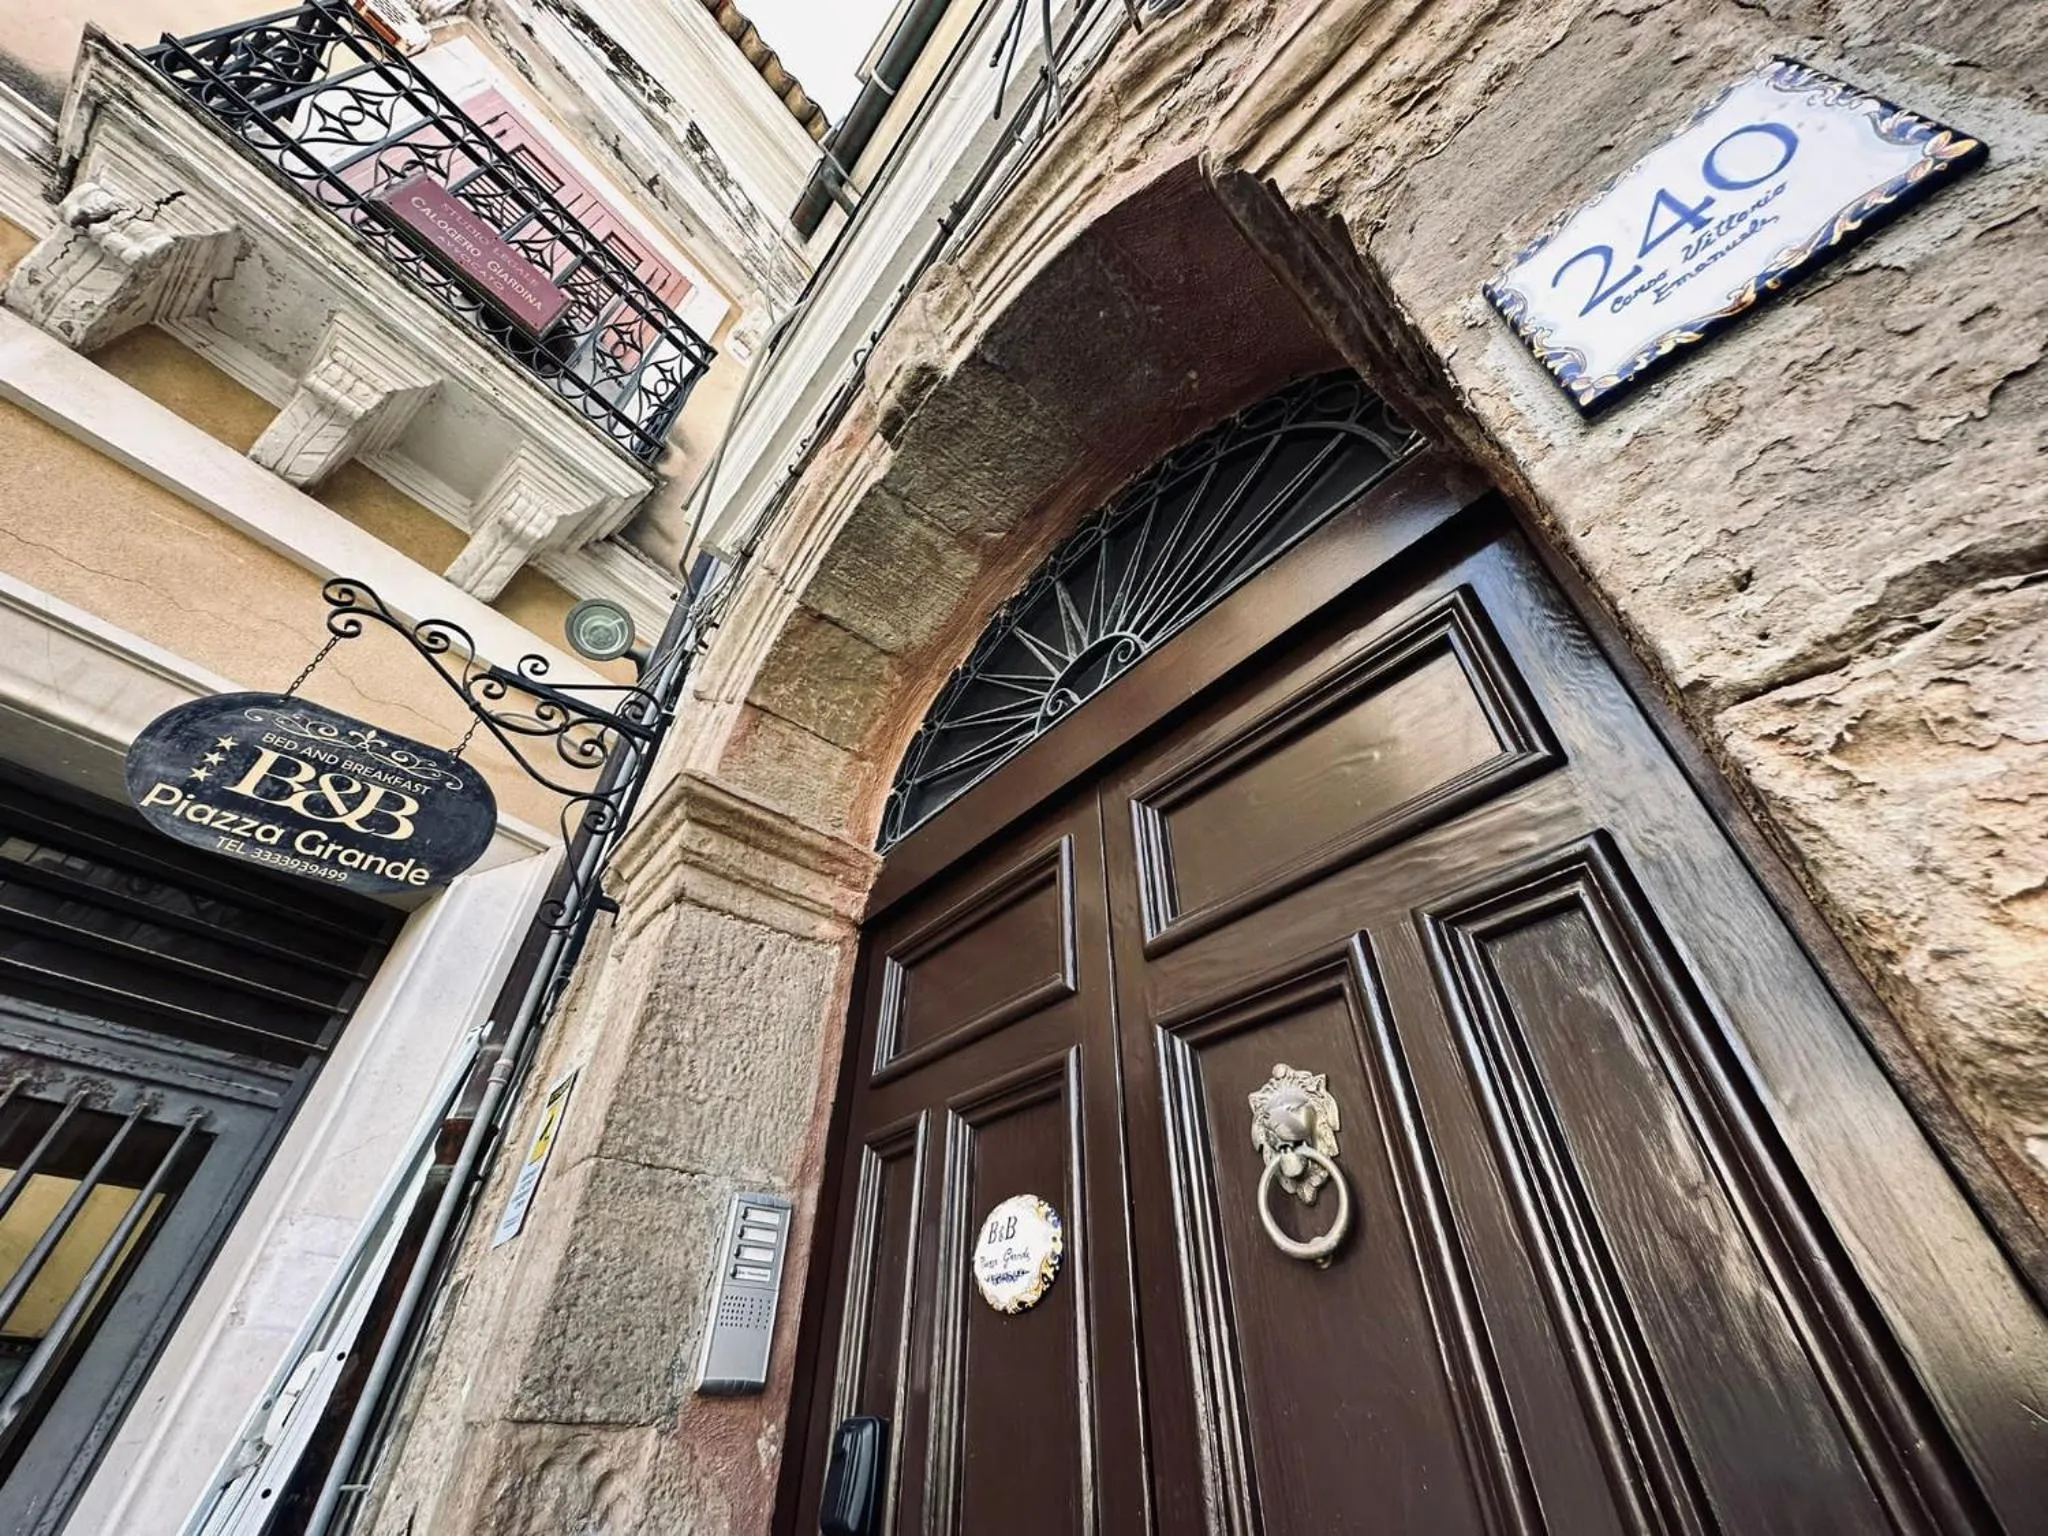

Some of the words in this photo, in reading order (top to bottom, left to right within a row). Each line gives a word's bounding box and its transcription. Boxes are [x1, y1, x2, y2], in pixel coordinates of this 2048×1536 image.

[411, 196, 481, 257] CALOGERO
[487, 260, 543, 311] GIARDINA
[437, 236, 504, 290] AVVOCATO
[441, 203, 489, 245] STUDIO
[493, 247, 539, 286] LEGALE
[1552, 122, 1799, 318] 240
[1610, 268, 1669, 314] Corso
[1682, 181, 1787, 264] Vittorio
[222, 745, 420, 841] B&B
[262, 732, 299, 751] BED
[300, 746, 339, 766] AND
[341, 759, 432, 796] BREAKFAST
[140, 782, 282, 845] Piazza
[294, 829, 431, 886] Grande
[216, 835, 247, 857] TEL
[254, 847, 348, 883] 3333939499
